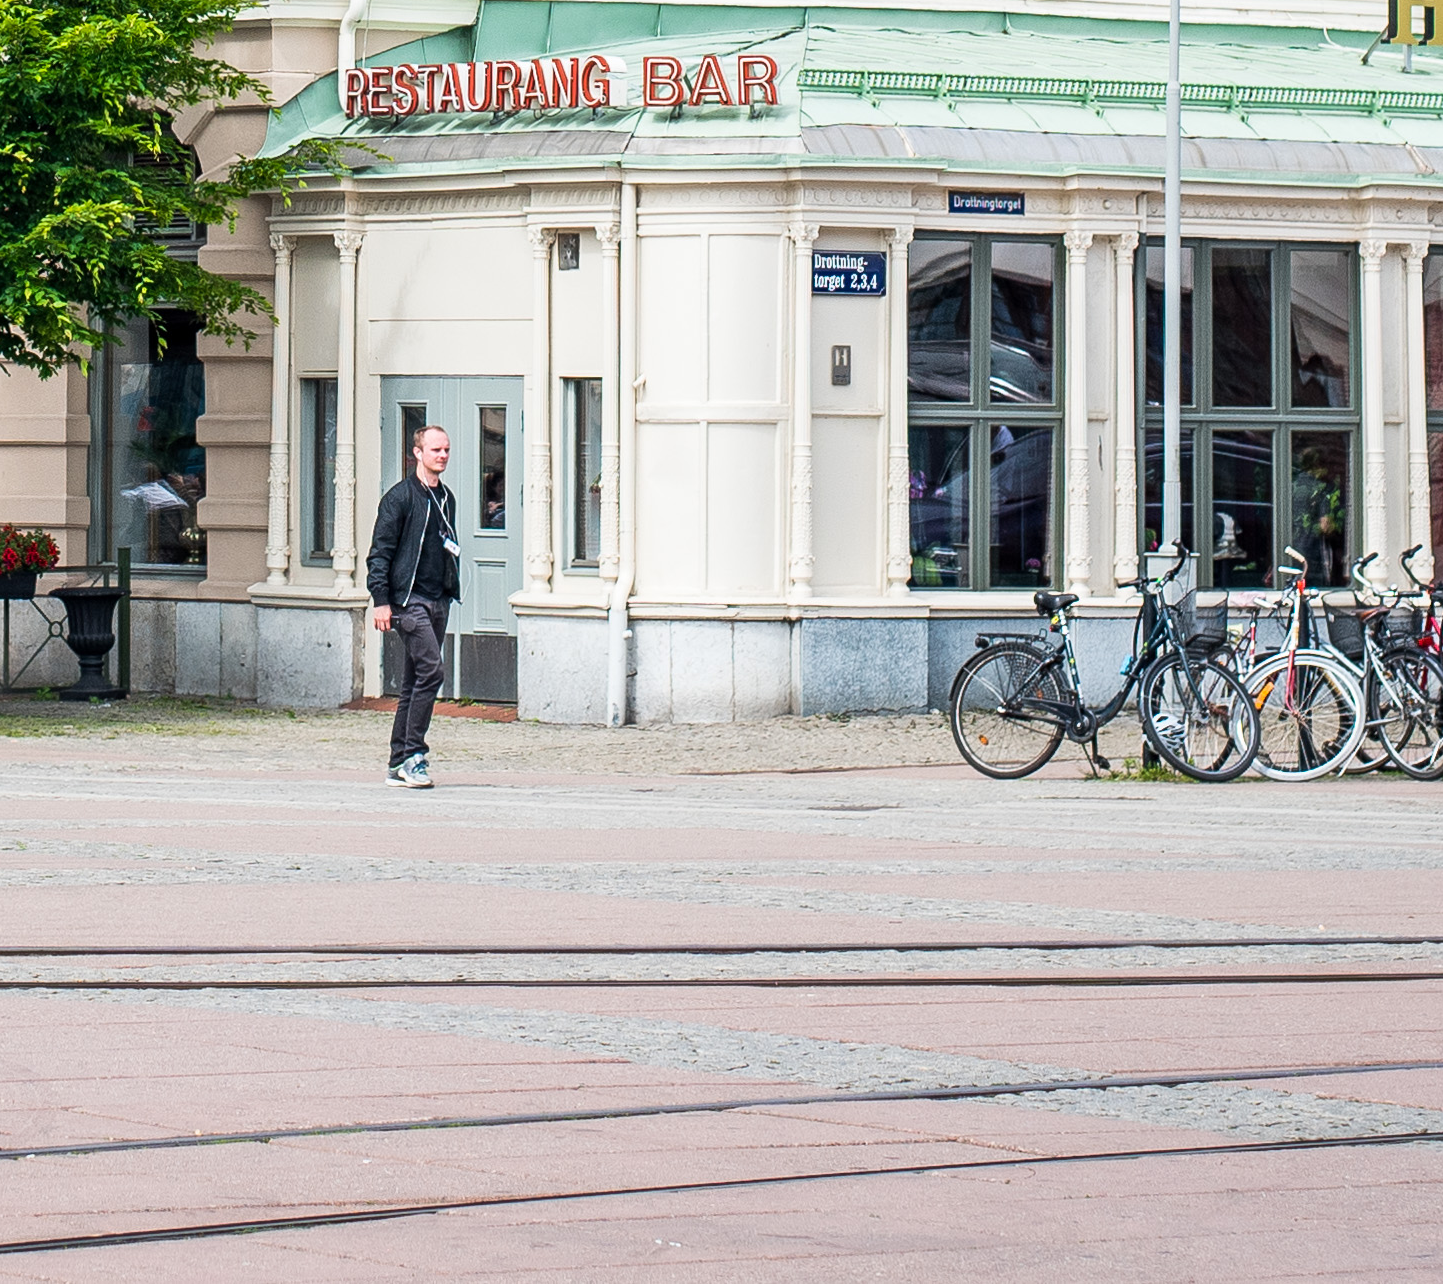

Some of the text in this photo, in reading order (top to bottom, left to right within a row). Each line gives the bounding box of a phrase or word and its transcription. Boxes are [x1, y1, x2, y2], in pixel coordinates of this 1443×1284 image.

[345, 53, 780, 118] RESTAURANG BAR
[953, 194, 1022, 212] Drottningtorget
[814, 253, 869, 272] Drottning-
[813, 273, 878, 291] torget 2,3,4
